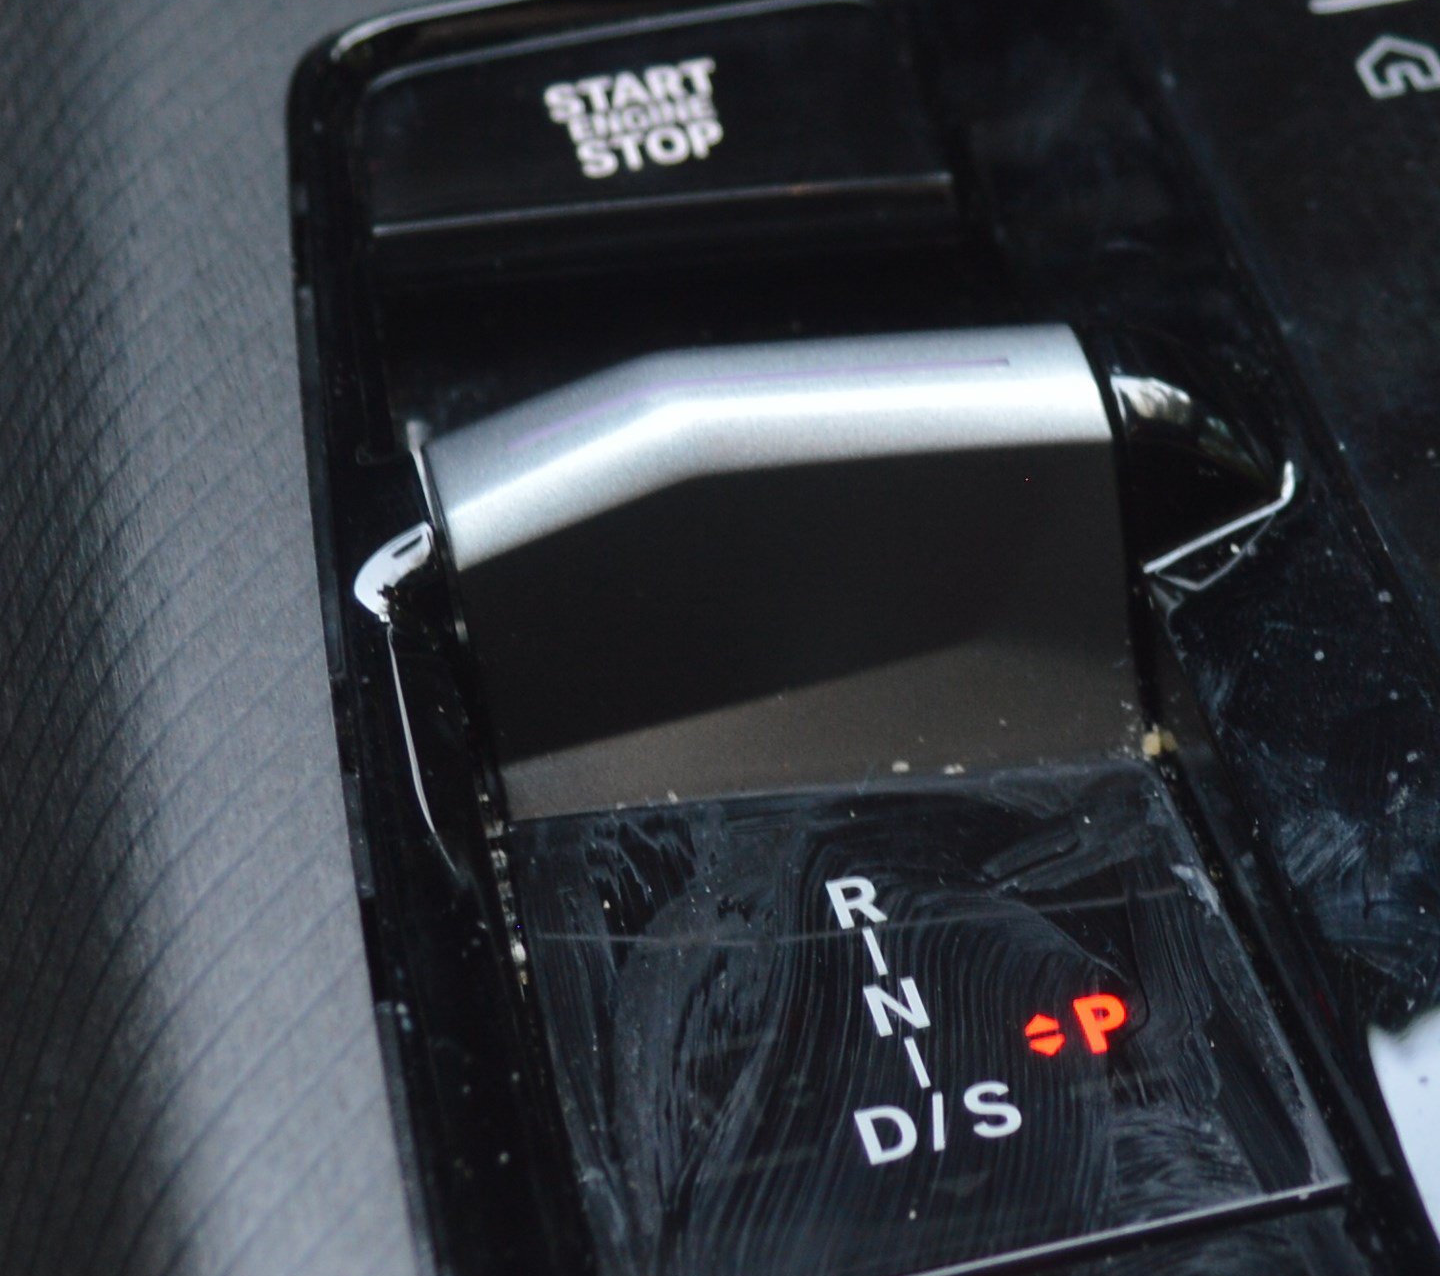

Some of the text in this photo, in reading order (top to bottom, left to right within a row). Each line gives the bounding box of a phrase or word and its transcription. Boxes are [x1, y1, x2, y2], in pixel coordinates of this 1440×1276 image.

[543, 55, 717, 125] START
[575, 118, 725, 180] STOP
[824, 875, 888, 929] R
[862, 976, 932, 1038] N
[1073, 993, 1128, 1055] P
